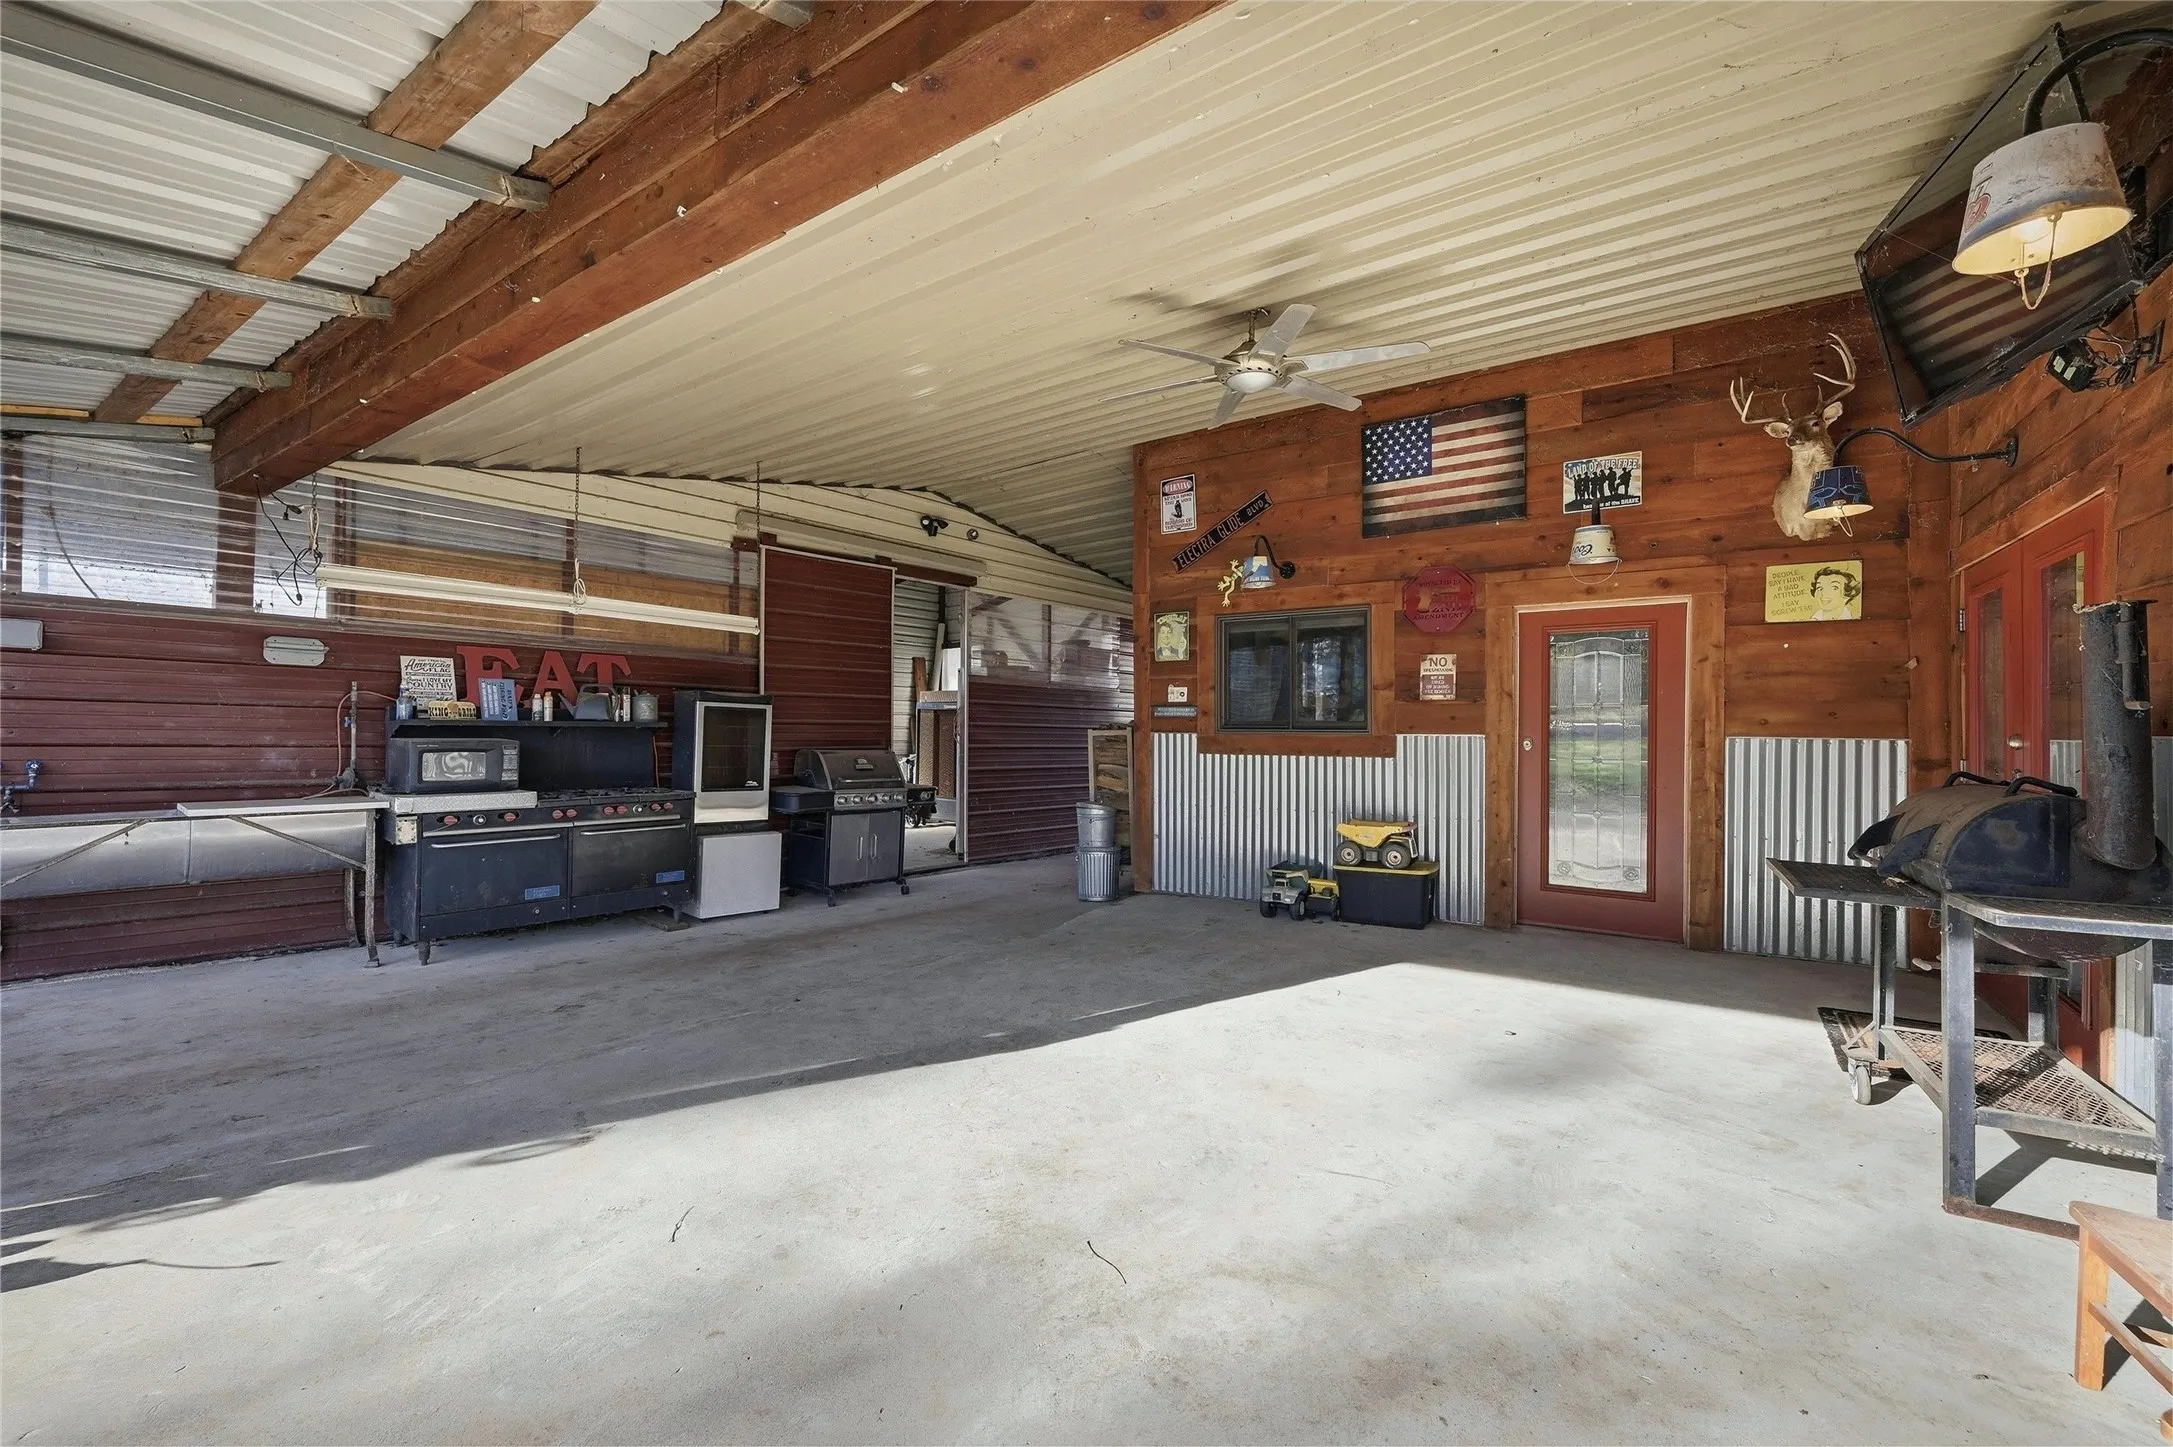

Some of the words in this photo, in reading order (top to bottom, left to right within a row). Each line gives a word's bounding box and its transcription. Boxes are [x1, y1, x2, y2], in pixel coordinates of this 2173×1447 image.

[1567, 464, 1587, 478] LAND
[1588, 461, 1600, 473] OF
[1601, 460, 1616, 471] THE
[1618, 458, 1638, 470] FREE
[1177, 534, 1216, 567] ELECTRA
[1217, 512, 1244, 538] GLIDE
[1246, 500, 1264, 516] BLVD
[1772, 569, 1800, 579] PEOPLE
[1786, 576, 1806, 584] HAVE
[404, 658, 451, 672] American
[1429, 656, 1448, 667] NO
[457, 645, 632, 709] EAT
[429, 706, 449, 717] KING
